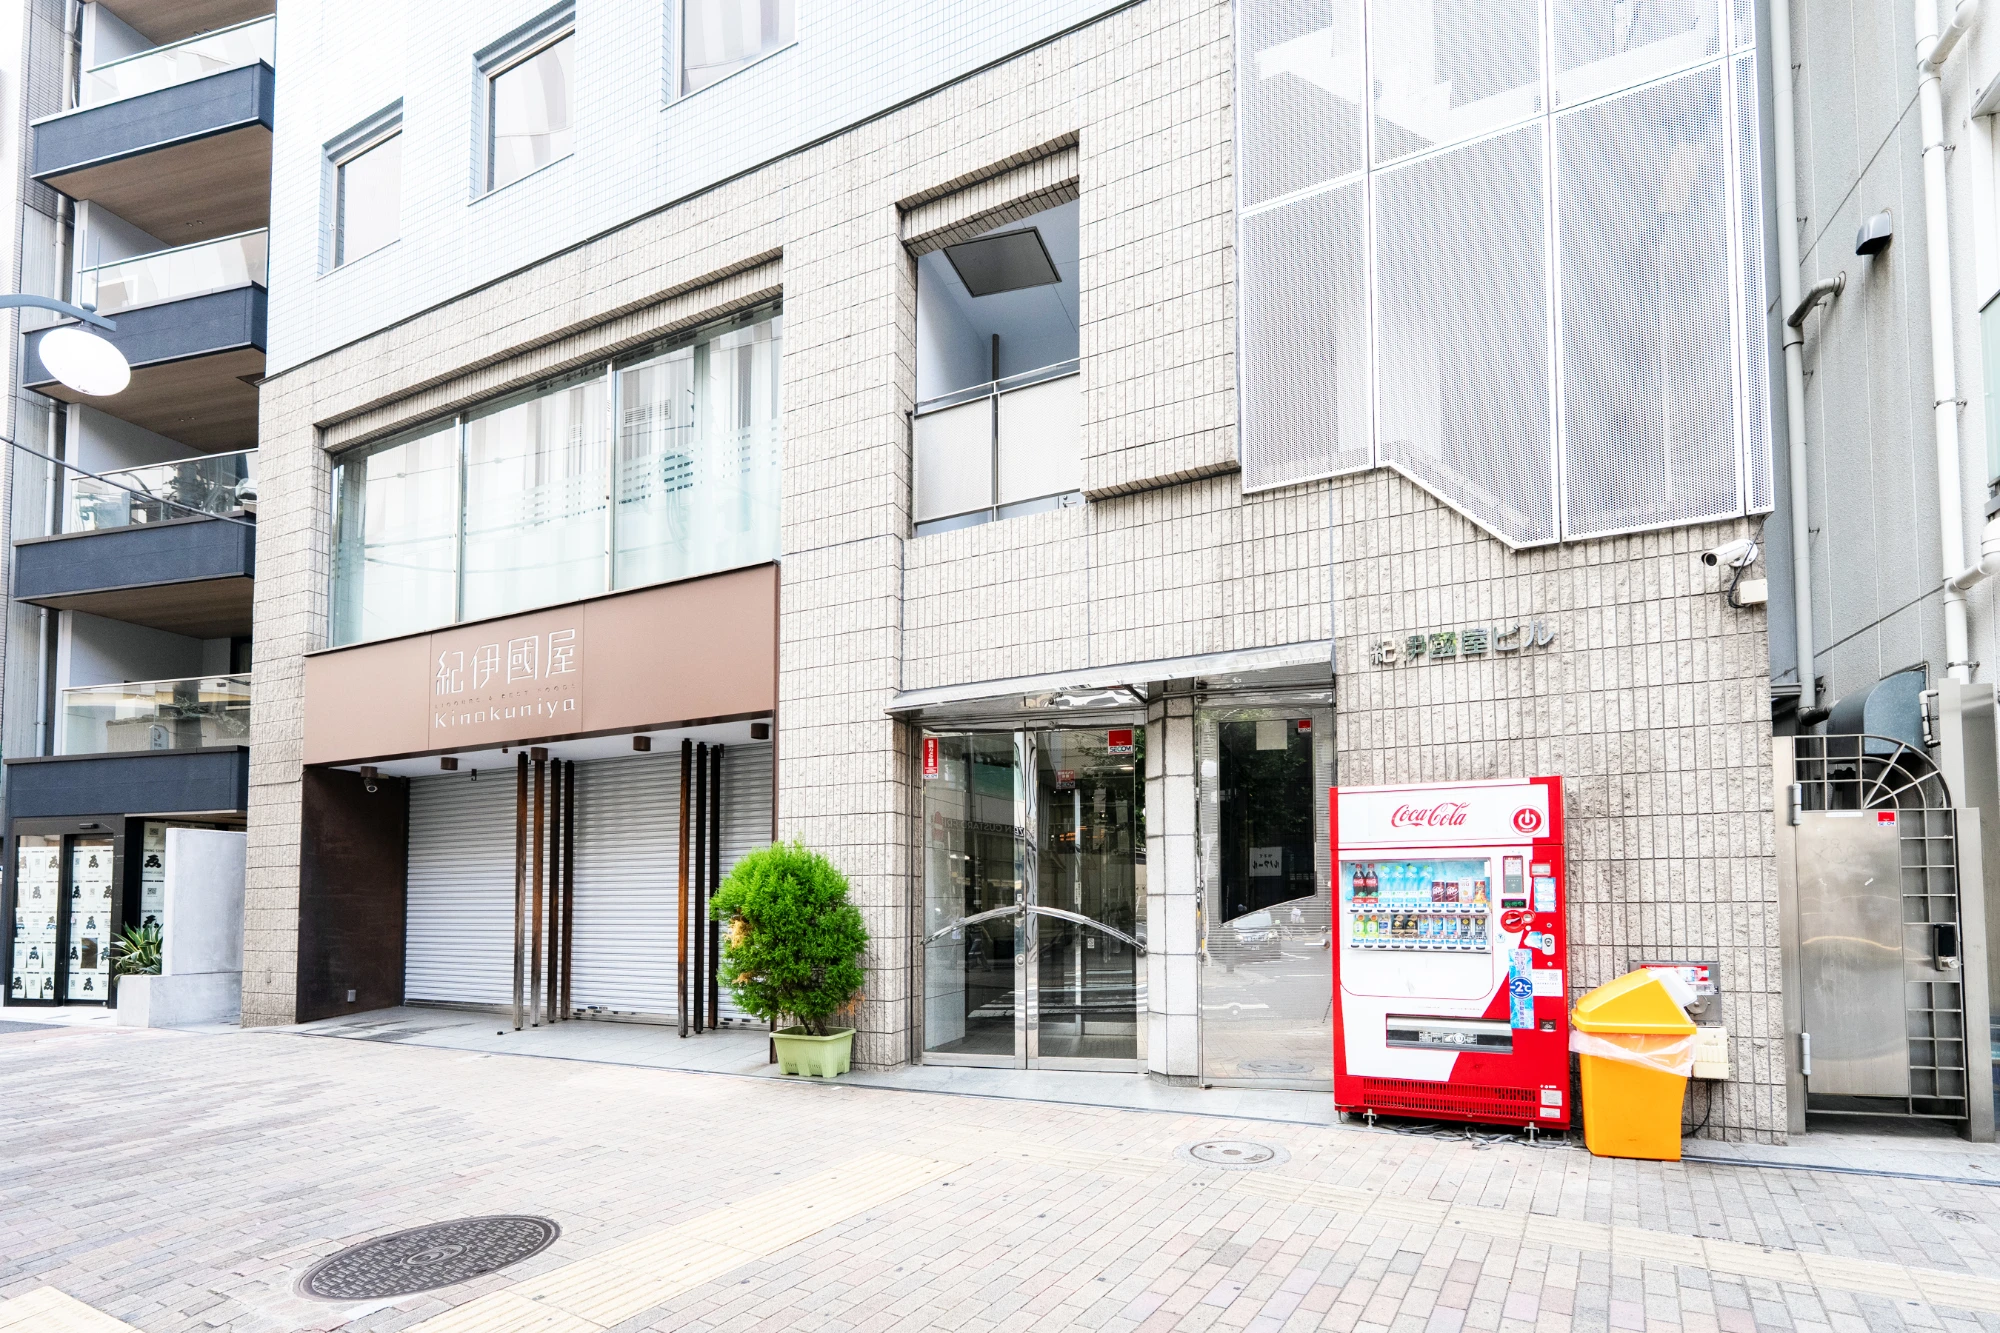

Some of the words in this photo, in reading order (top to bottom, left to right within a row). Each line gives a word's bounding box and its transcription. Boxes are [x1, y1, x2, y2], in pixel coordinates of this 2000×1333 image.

[436, 627, 576, 695] 紀伊國屋
[1371, 620, 1555, 665] 紀伊國屋ビル
[435, 697, 575, 728] Kinokuniya
[1391, 802, 1471, 828] Coca-Cola
